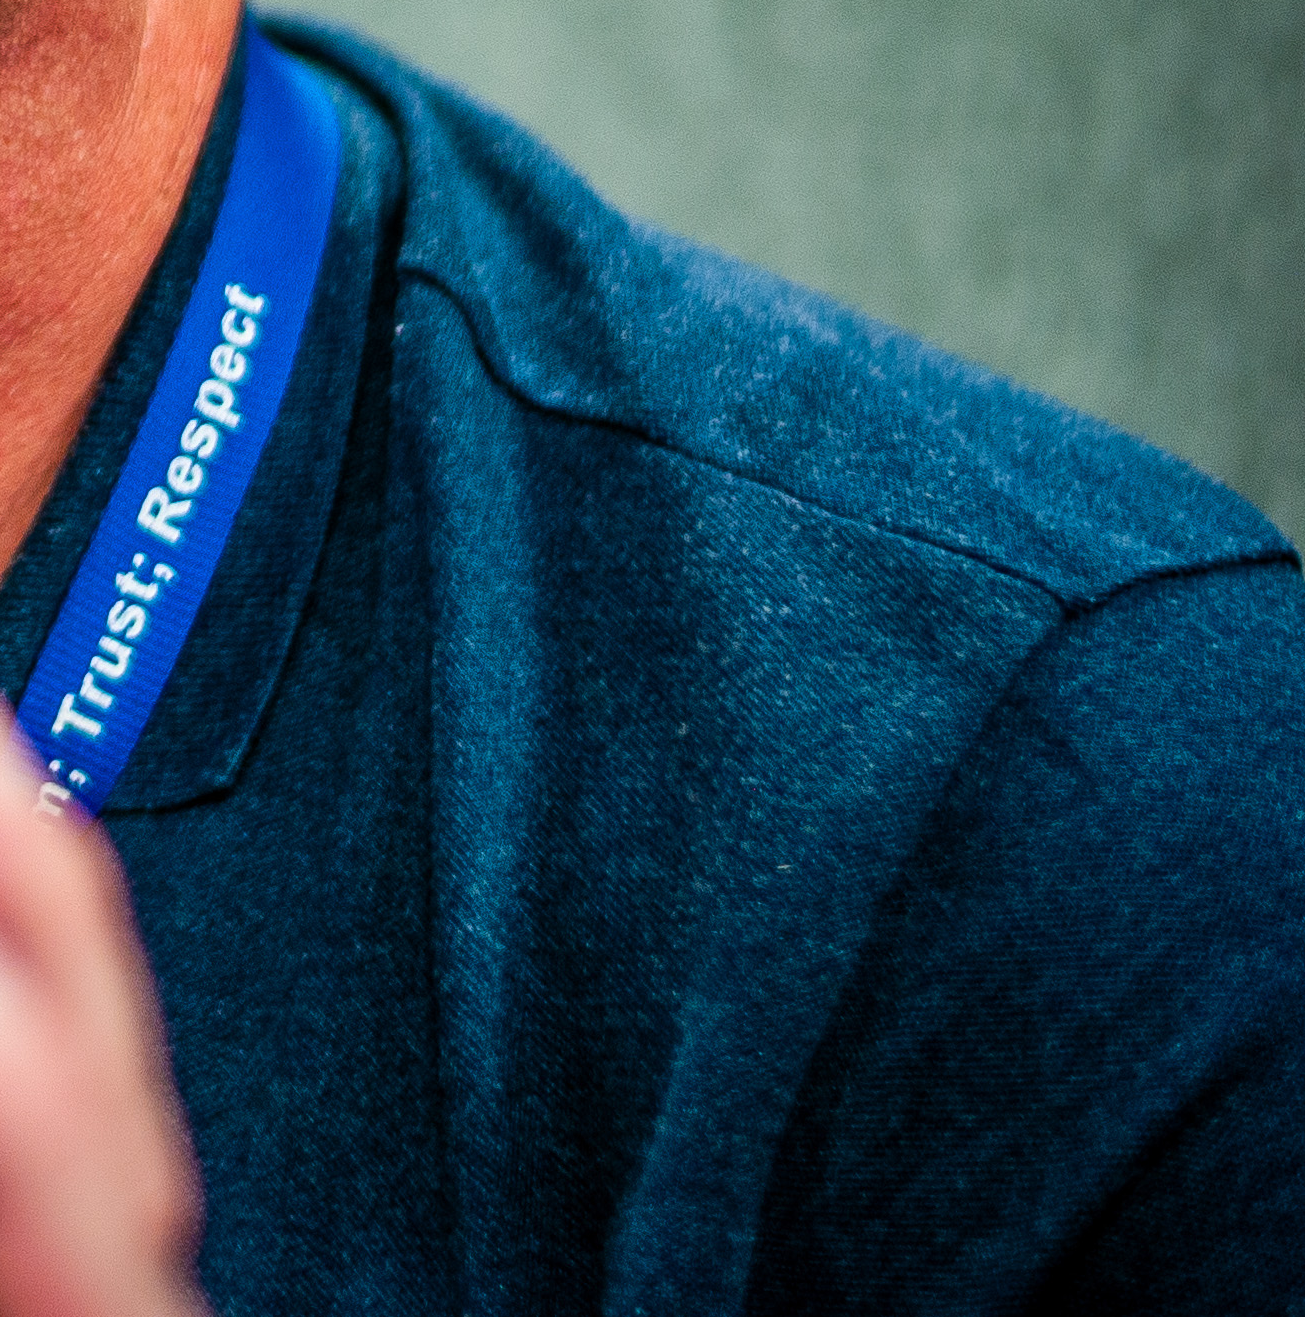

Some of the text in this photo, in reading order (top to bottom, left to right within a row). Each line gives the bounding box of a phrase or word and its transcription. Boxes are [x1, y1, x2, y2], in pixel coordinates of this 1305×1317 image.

[37, 283, 266, 816] n; Trust; Respect
